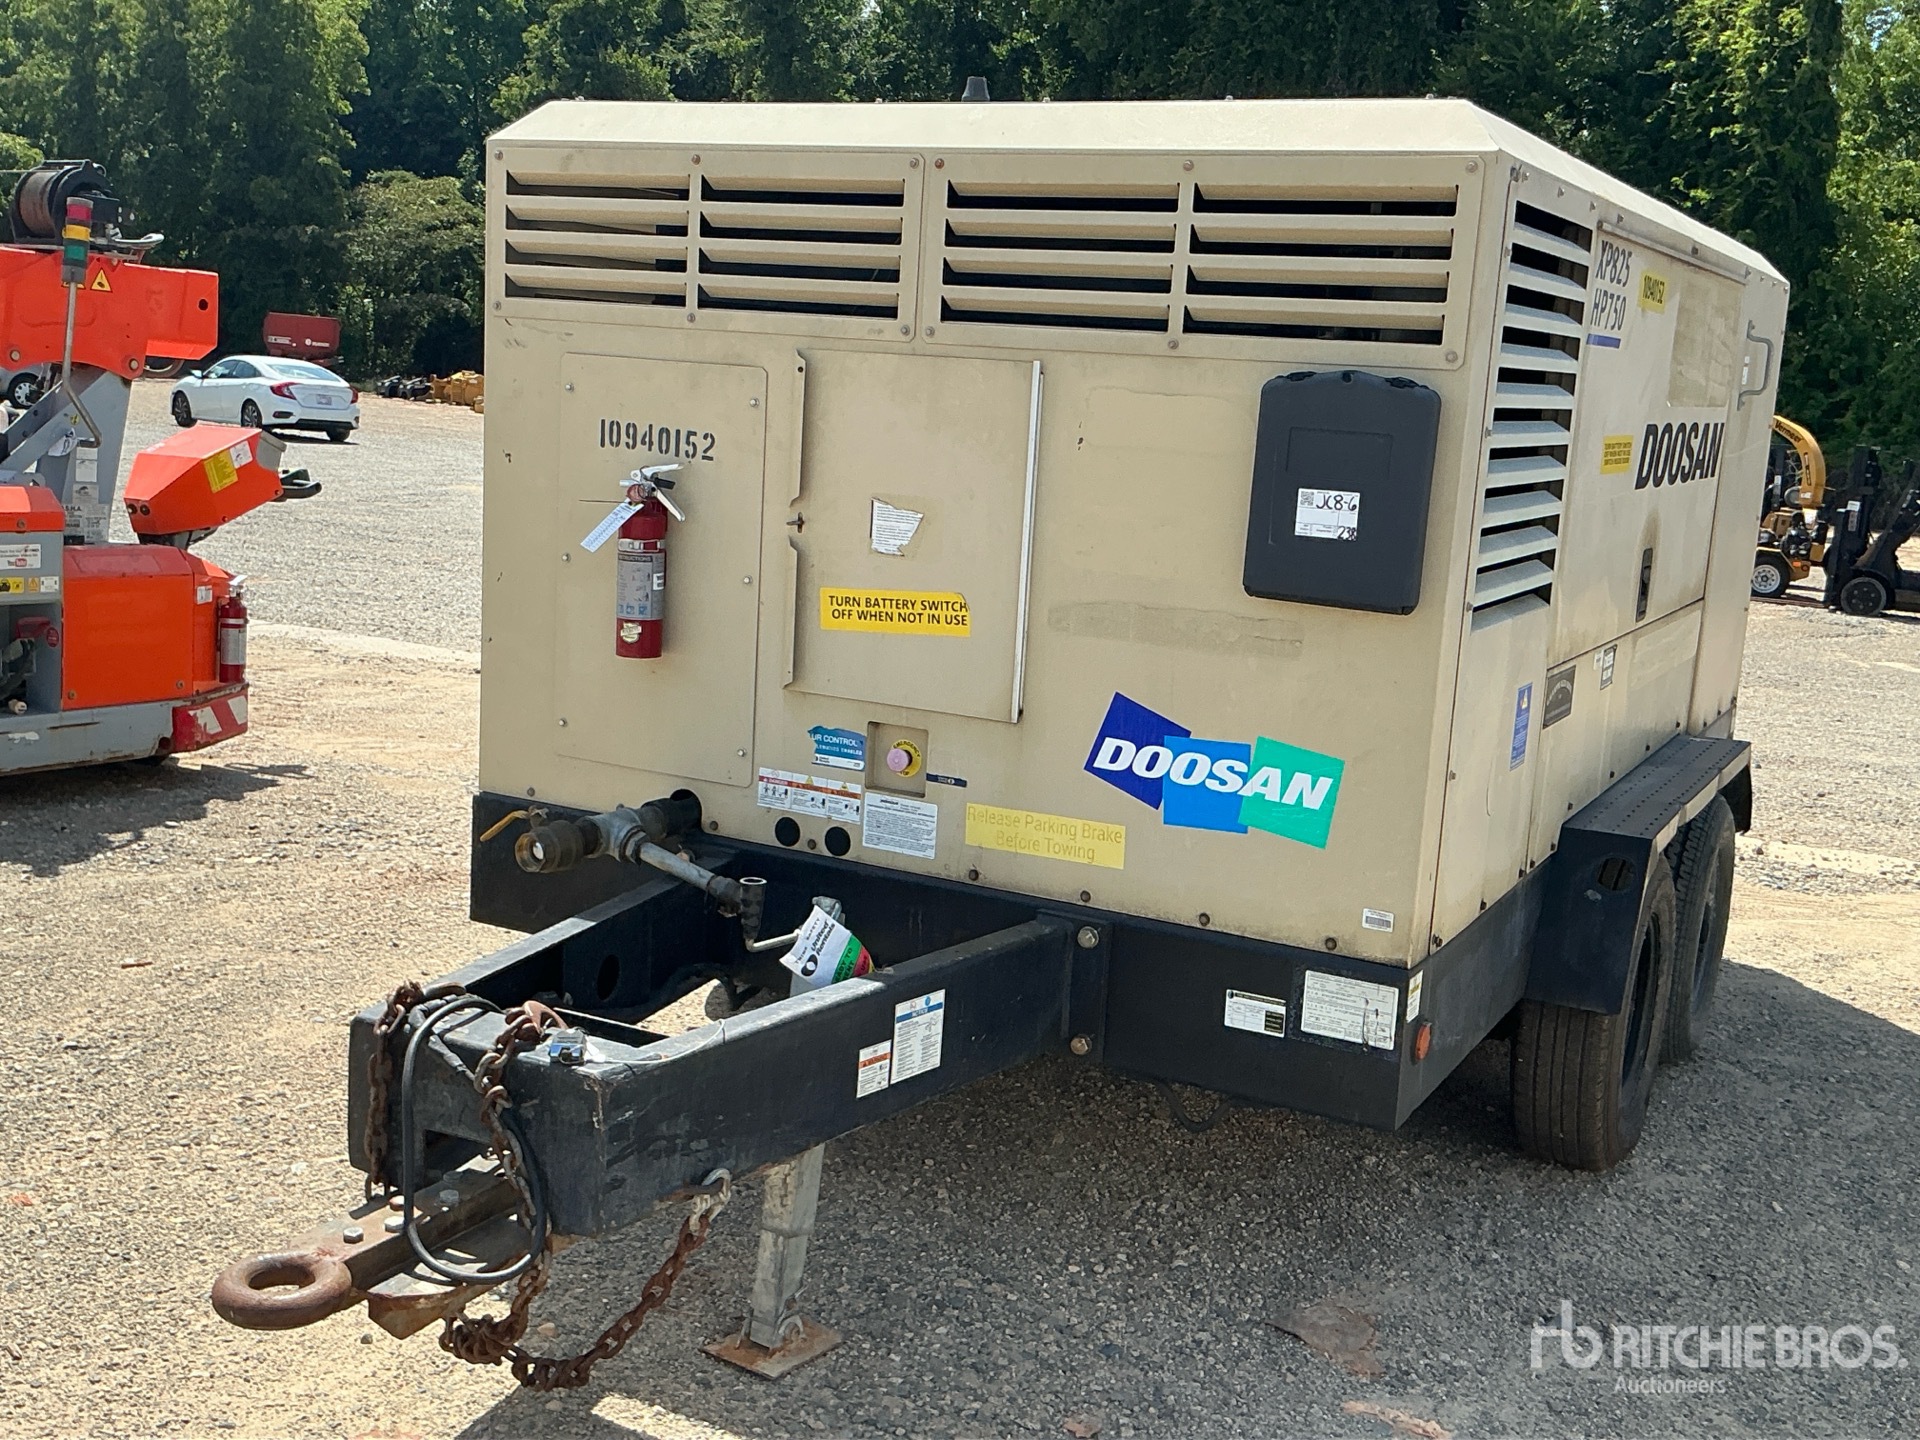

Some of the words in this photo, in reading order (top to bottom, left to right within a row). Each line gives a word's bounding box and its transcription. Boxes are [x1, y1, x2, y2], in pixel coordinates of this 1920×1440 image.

[1595, 239, 1632, 287] XP825
[1590, 288, 1627, 331] HP750
[600, 418, 716, 462] 10940152
[1634, 421, 1725, 491] DOOSAN
[828, 595, 861, 608] TURN
[864, 597, 917, 611] BATTERY
[920, 600, 968, 612] SWITCH
[831, 608, 853, 620] OFF
[857, 610, 894, 622] WHEN
[897, 612, 924, 624] NOT
[927, 613, 941, 625] IN
[944, 614, 968, 626] USE
[823, 734, 858, 747] CONTROL
[1092, 736, 1334, 811] DOOSAN
[967, 806, 1021, 828] Release
[1024, 814, 1077, 840] Parking
[1081, 823, 1123, 844] Brake
[995, 829, 1041, 853] Before
[1044, 837, 1096, 863] Towing
[810, 919, 829, 951] United
[816, 923, 835, 956] Rentals
